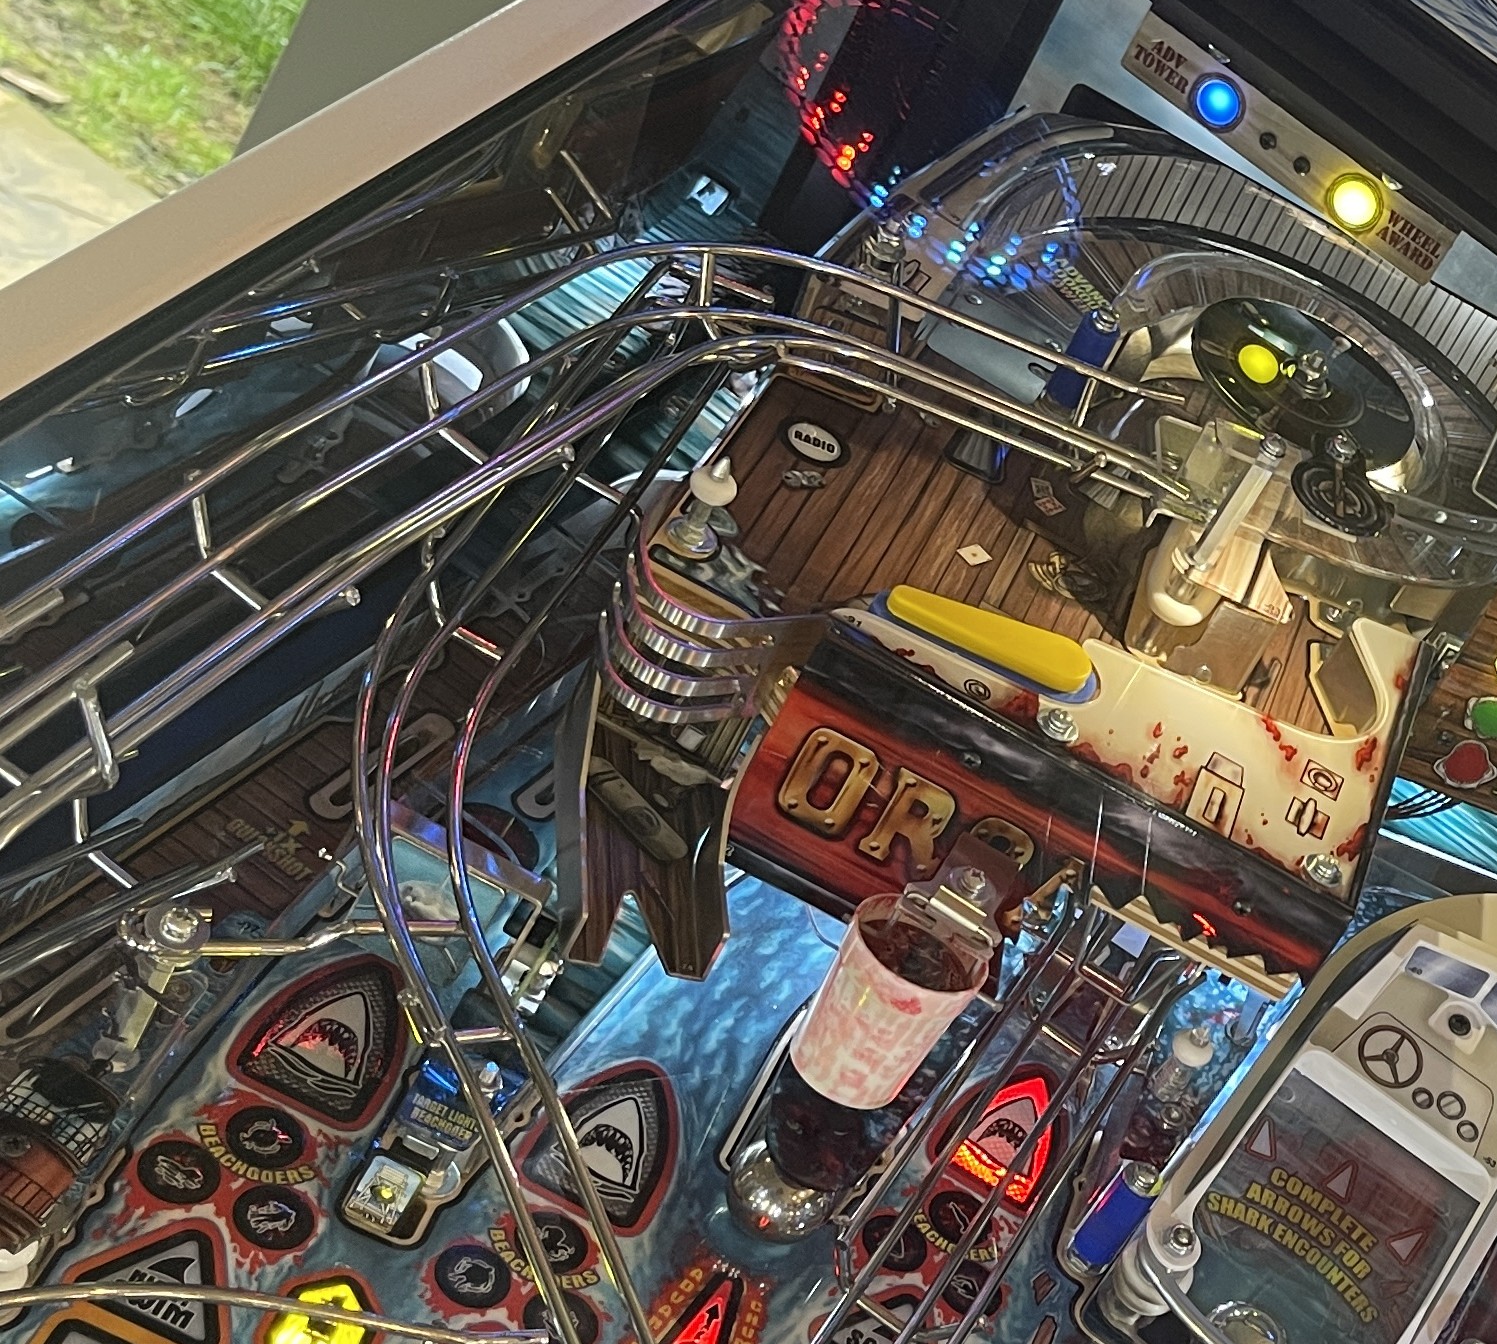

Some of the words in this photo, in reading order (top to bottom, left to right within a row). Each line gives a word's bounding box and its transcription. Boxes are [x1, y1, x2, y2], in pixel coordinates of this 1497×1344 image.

[1134, 43, 1189, 95] TOWER
[1149, 38, 1185, 72] ADV
[1377, 226, 1433, 274] AWARD
[1386, 209, 1443, 260] WHEEL
[793, 426, 837, 455] RADIO
[410, 1107, 473, 1141] BEACHGOER
[412, 1093, 450, 1121] TARGET
[446, 1109, 480, 1133] LIGHT
[197, 1123, 316, 1185] BEACHGOERS
[1245, 1182, 1339, 1238] ARROWS
[1328, 1233, 1370, 1280] FOR
[1270, 1166, 1377, 1250] COMPLETE
[1207, 1192, 1277, 1236] SHARK
[1267, 1225, 1378, 1324] ENCOUNTERS
